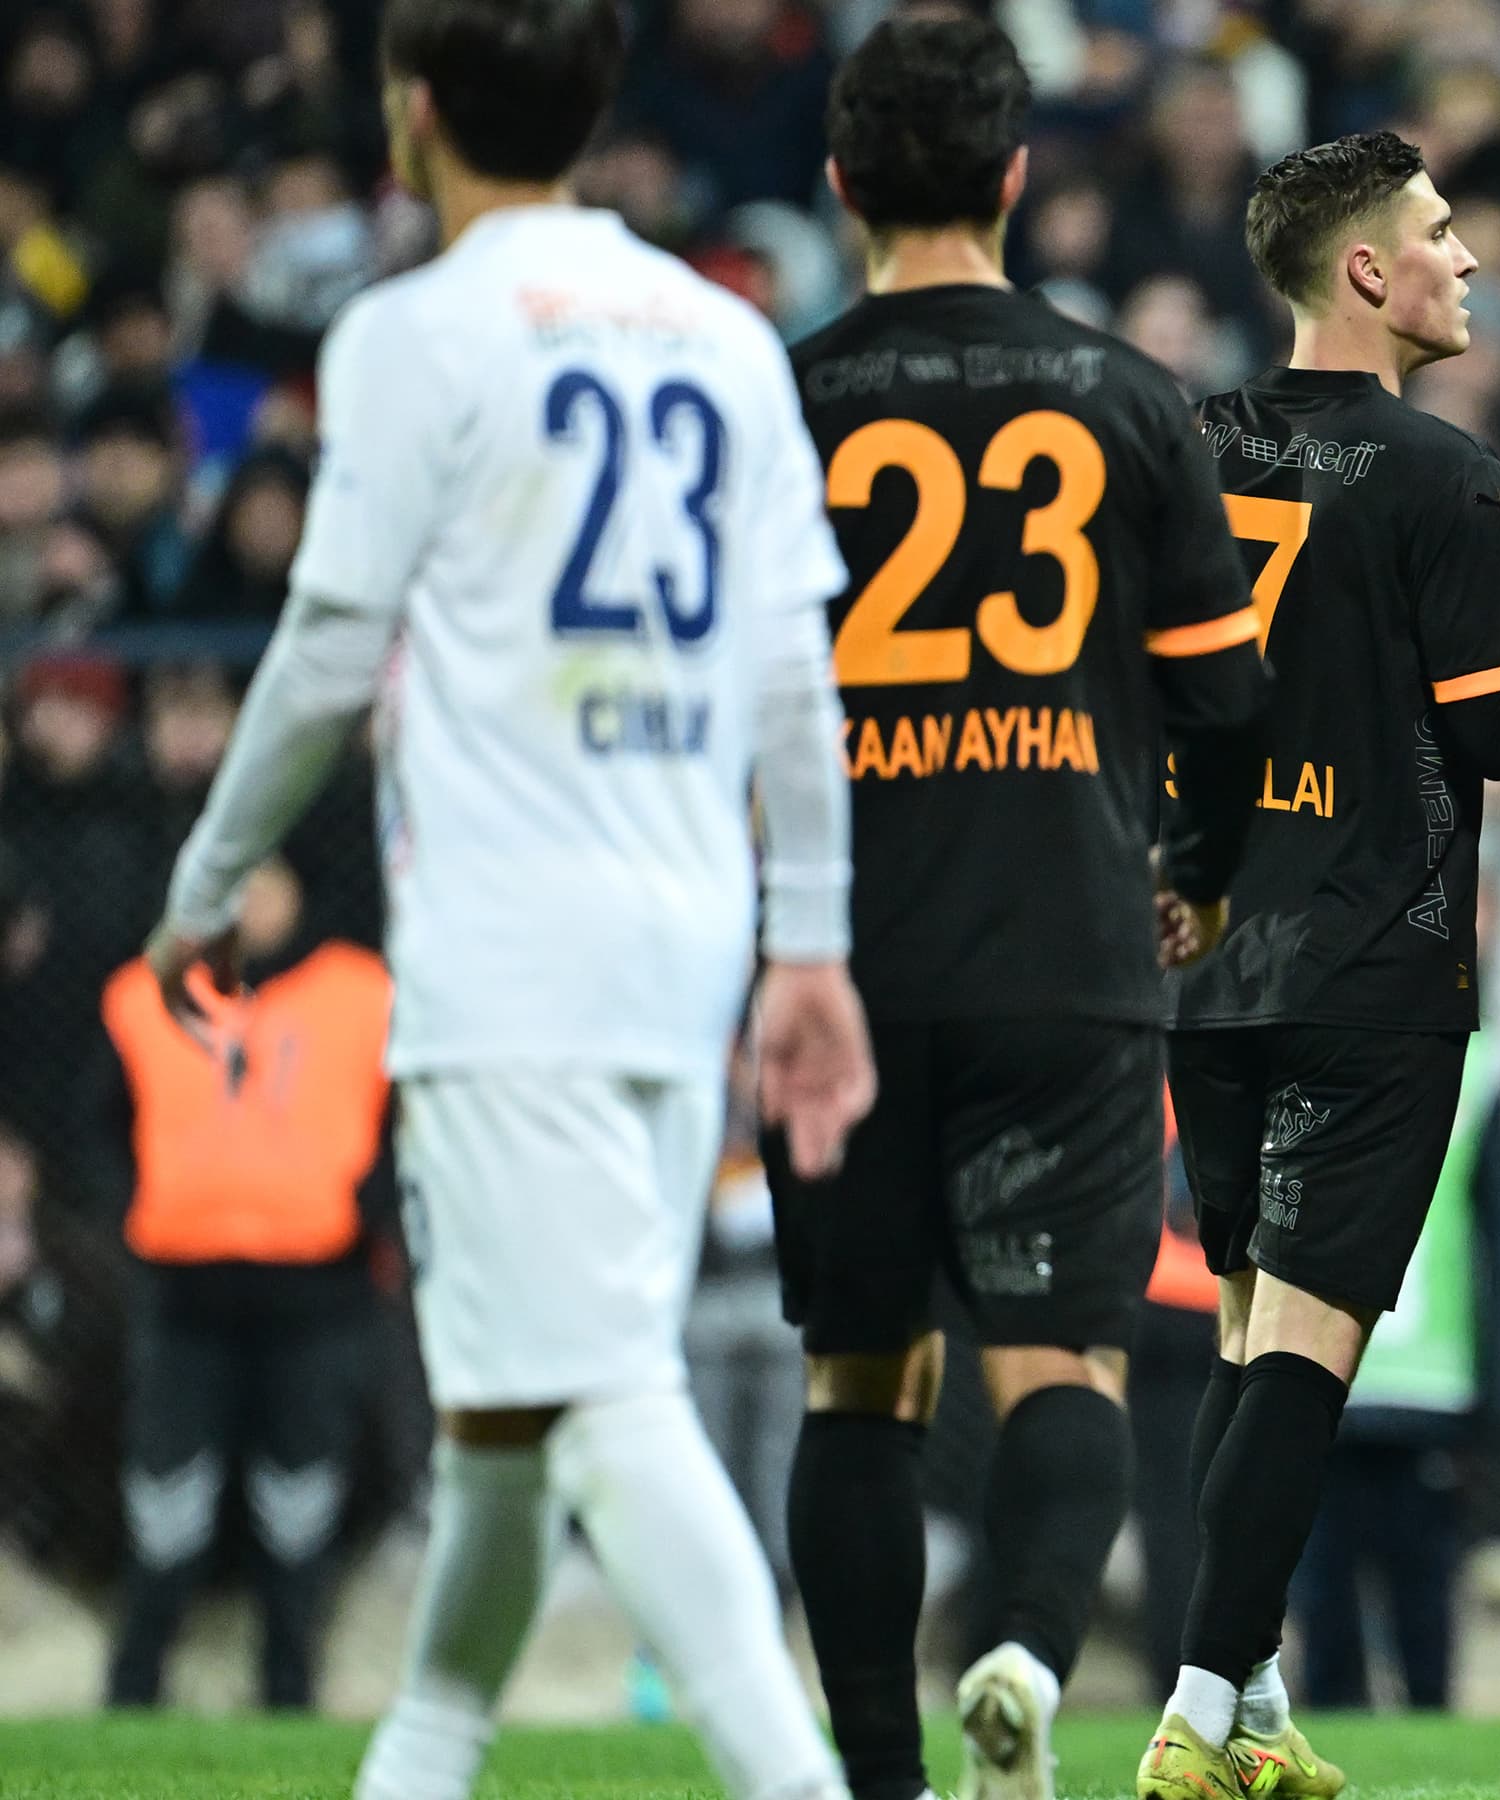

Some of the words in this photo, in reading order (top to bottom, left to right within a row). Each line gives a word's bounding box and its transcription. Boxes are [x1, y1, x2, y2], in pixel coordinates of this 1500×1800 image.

[544, 368, 728, 644] 23
[829, 410, 1105, 686] 23
[1219, 493, 1312, 663] 7
